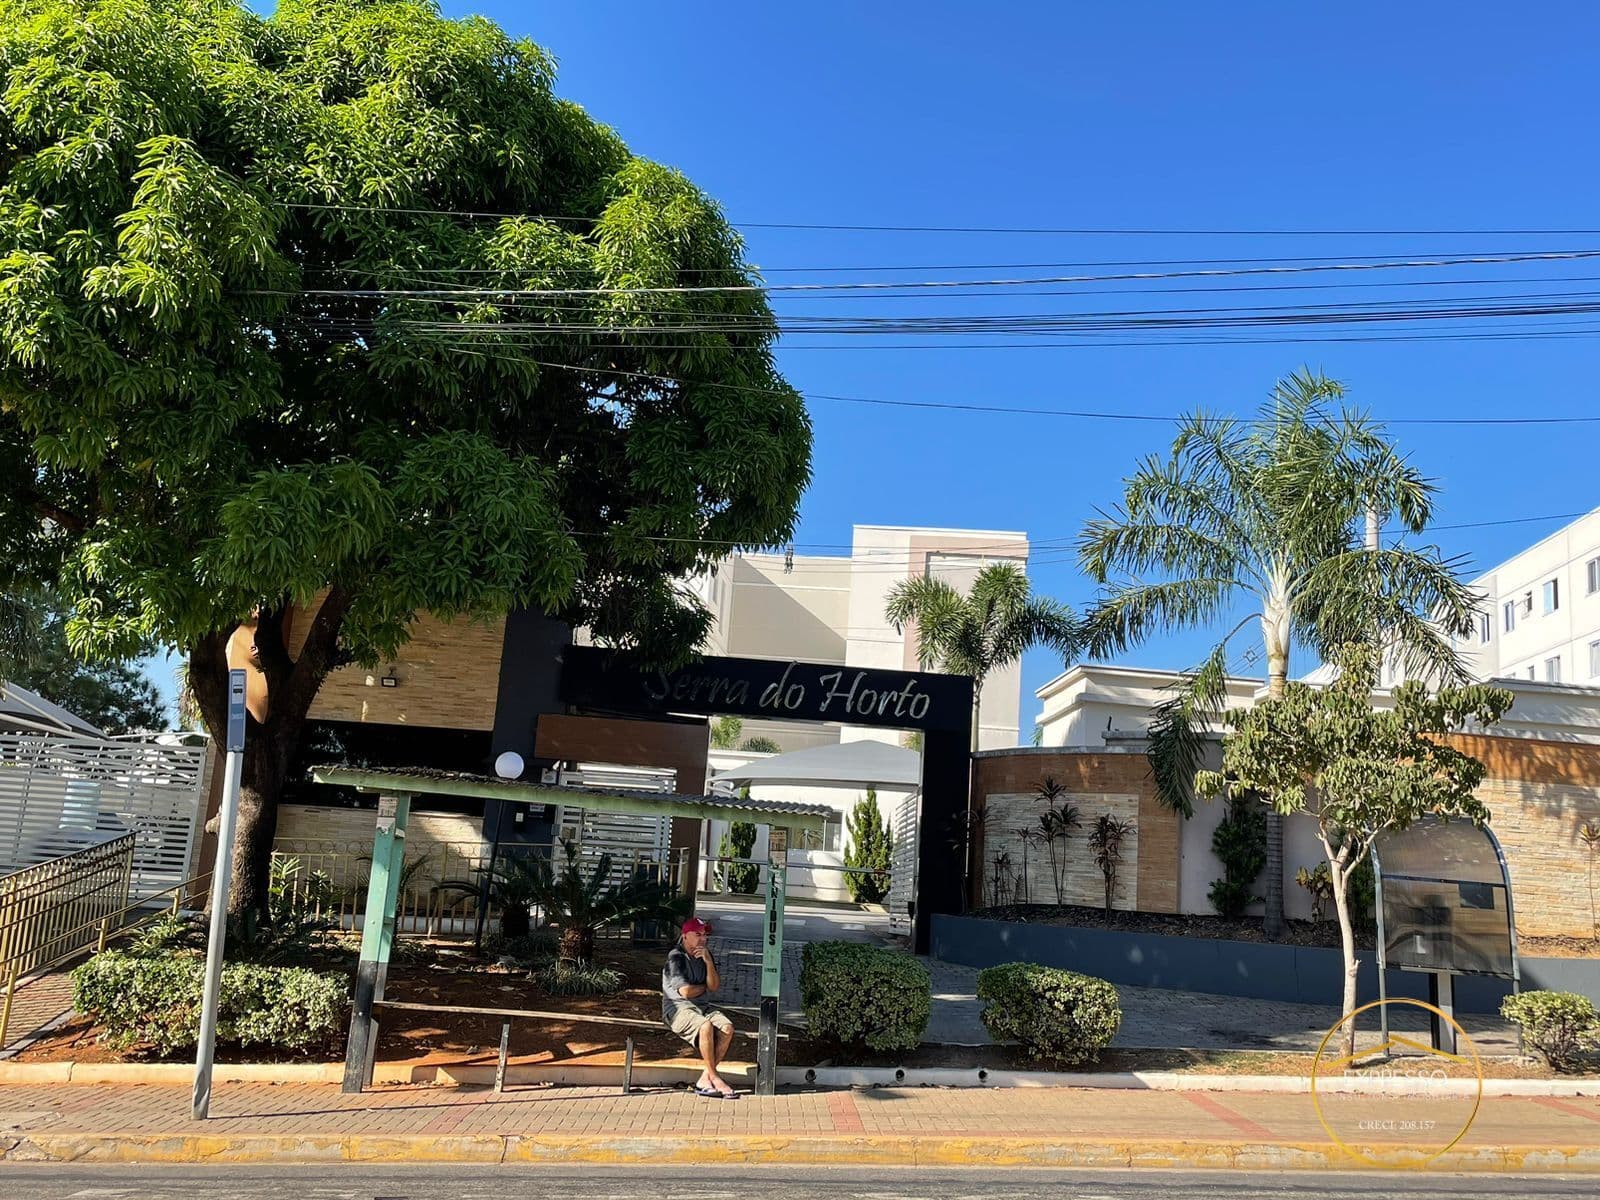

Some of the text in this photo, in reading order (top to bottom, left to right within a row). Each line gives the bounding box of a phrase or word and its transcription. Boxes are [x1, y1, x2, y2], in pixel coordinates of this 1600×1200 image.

[641, 660, 931, 720] Serra do Horto
